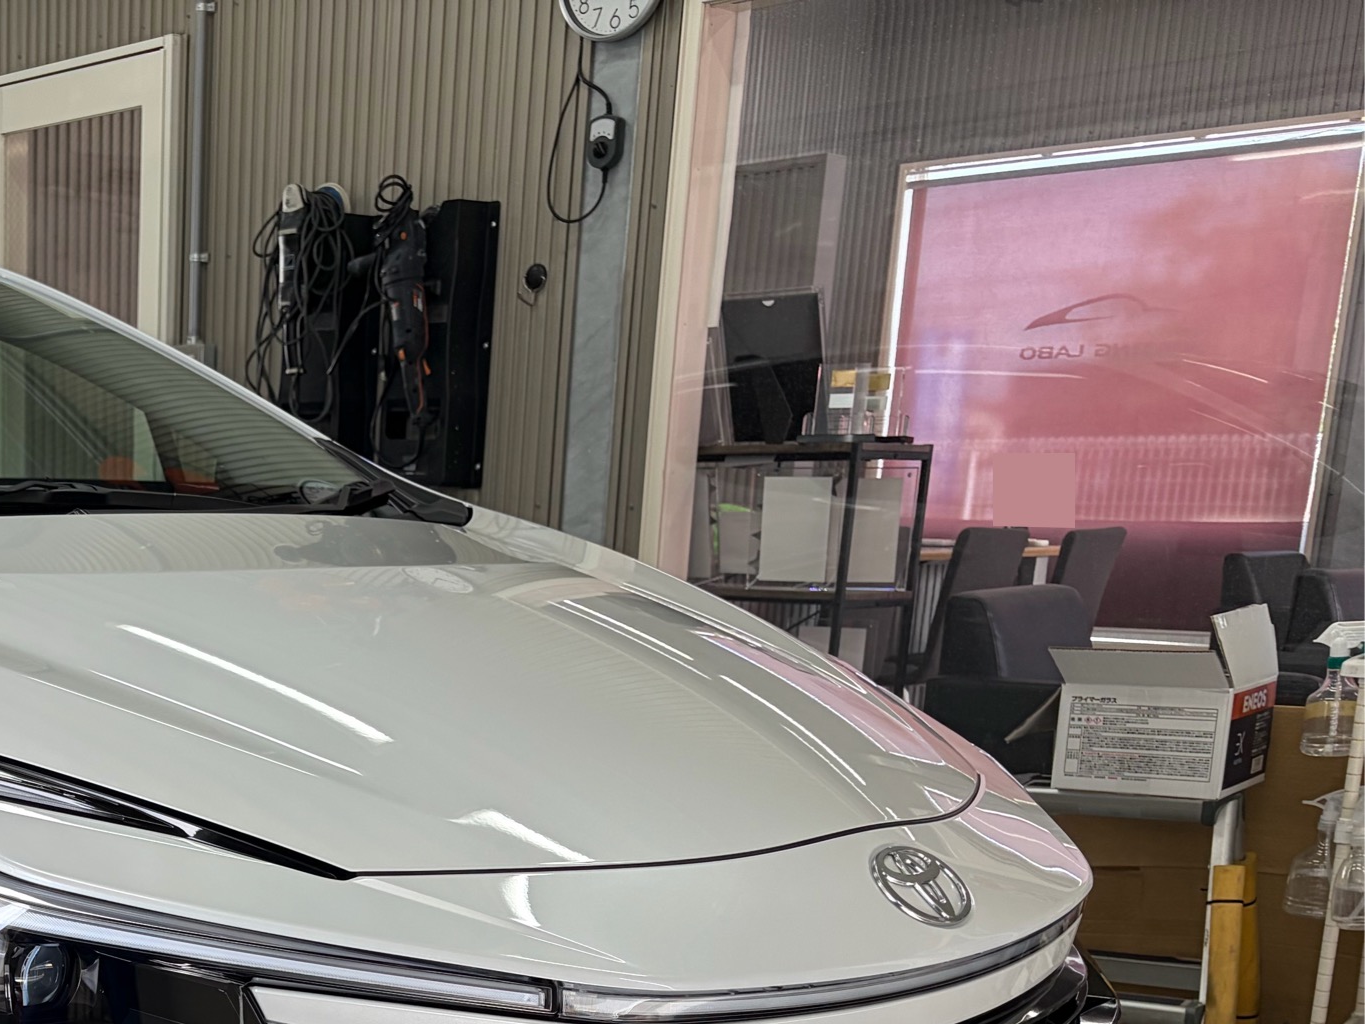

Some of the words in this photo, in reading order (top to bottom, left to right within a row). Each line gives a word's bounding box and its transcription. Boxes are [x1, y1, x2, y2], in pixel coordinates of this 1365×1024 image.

[593, 7, 603, 28] 7
[609, 8, 621, 29] 6
[628, 0, 640, 19] 5
[1071, 695, 1117, 703] プライマーガラス
[1242, 689, 1268, 713] ENEOS
